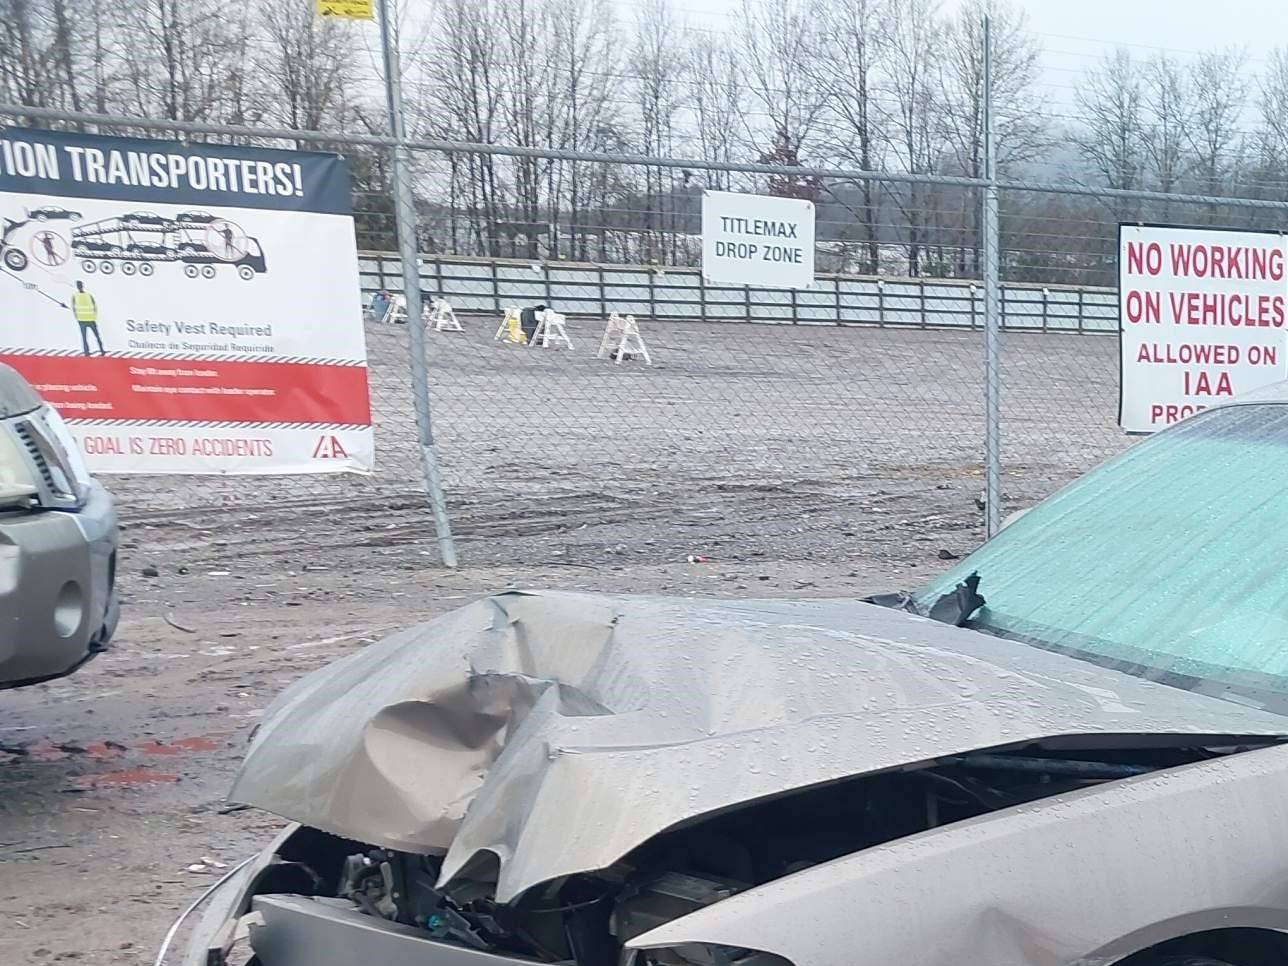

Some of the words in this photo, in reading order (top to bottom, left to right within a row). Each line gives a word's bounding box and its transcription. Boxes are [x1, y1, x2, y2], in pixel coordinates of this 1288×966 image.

[0, 139, 60, 180] ION
[63, 146, 304, 197] TRANSPORTERS!
[720, 216, 797, 239] TITLEMAX
[716, 241, 757, 259] DROP
[763, 245, 802, 263] ZONE
[1127, 241, 1162, 276] NO
[1170, 244, 1283, 281] WORKING
[1126, 290, 1160, 324] ON
[1169, 292, 1285, 327] VEHICLES
[126, 320, 171, 336] Safety
[175, 322, 206, 334] Vest
[209, 323, 272, 338] Required
[1137, 343, 1239, 364] ALLOWED
[1247, 346, 1276, 365] ON
[1184, 371, 1233, 396] IAA
[84, 436, 123, 455] GOAL
[129, 437, 143, 455] IS
[149, 438, 186, 456] ZERO
[192, 439, 273, 457] ACCIDENTS
